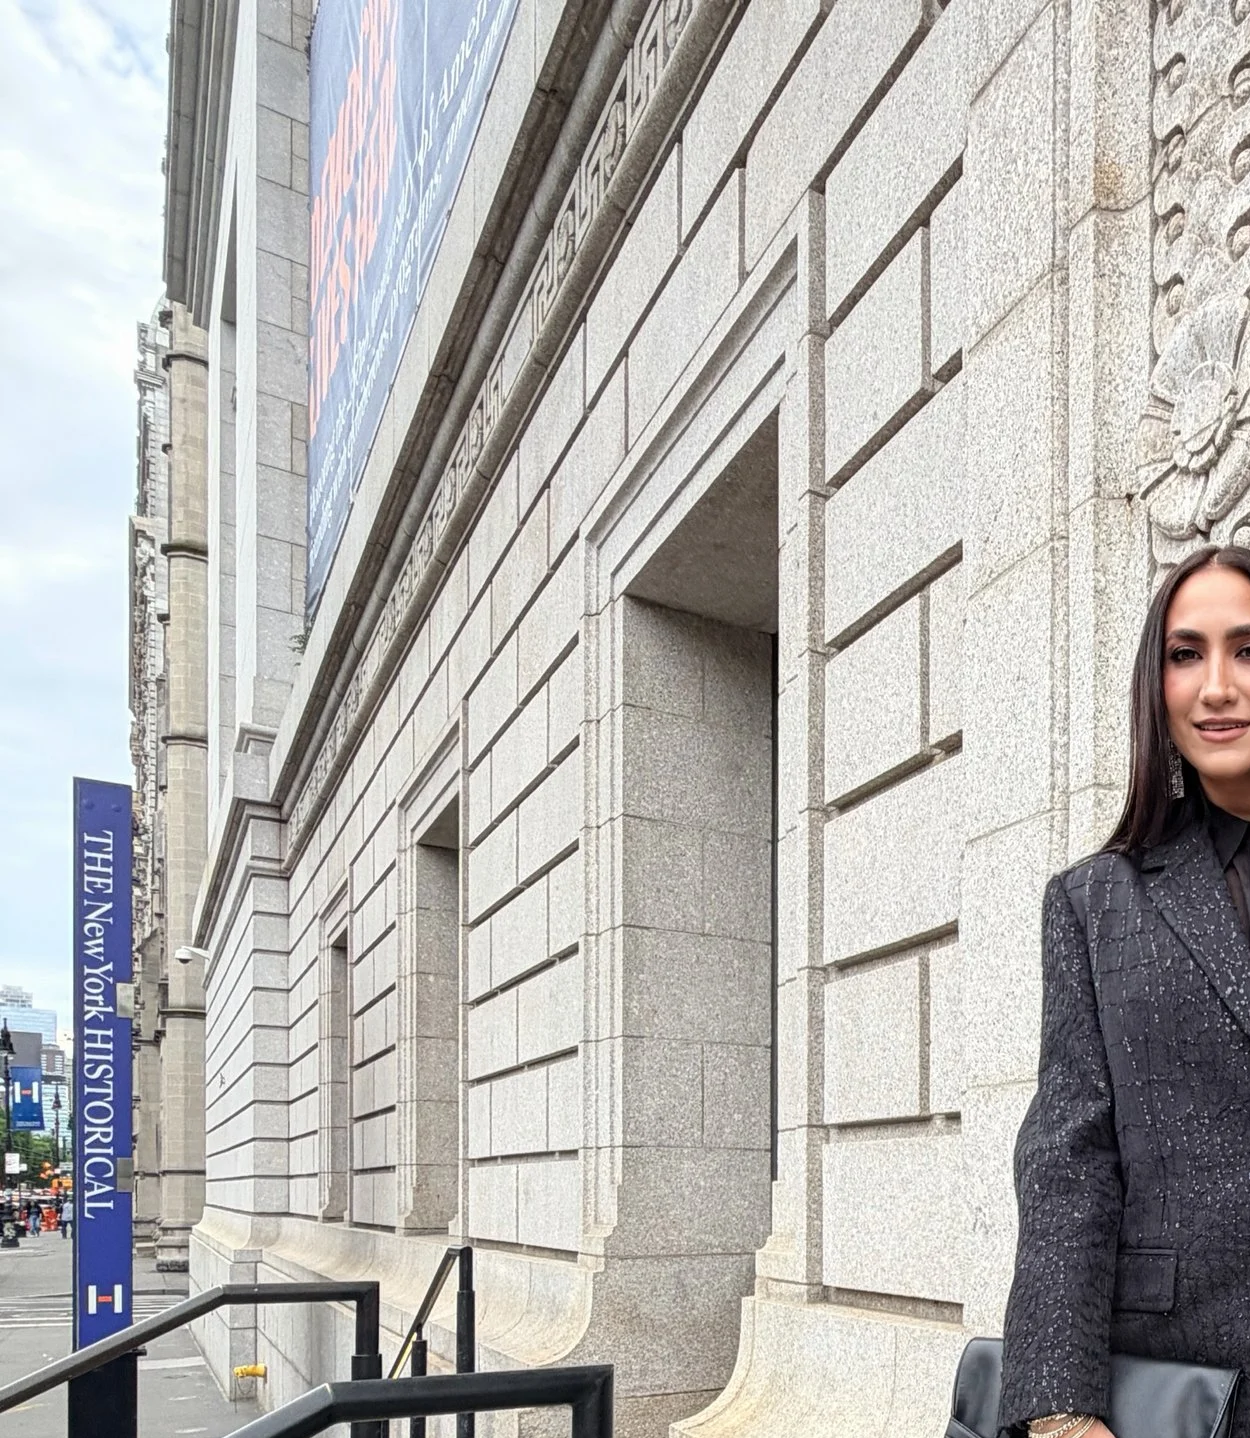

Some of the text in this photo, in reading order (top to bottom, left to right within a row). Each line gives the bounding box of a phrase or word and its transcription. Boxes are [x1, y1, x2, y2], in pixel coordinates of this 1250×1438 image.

[83, 829, 114, 1219] THE New York HISTORICAL
